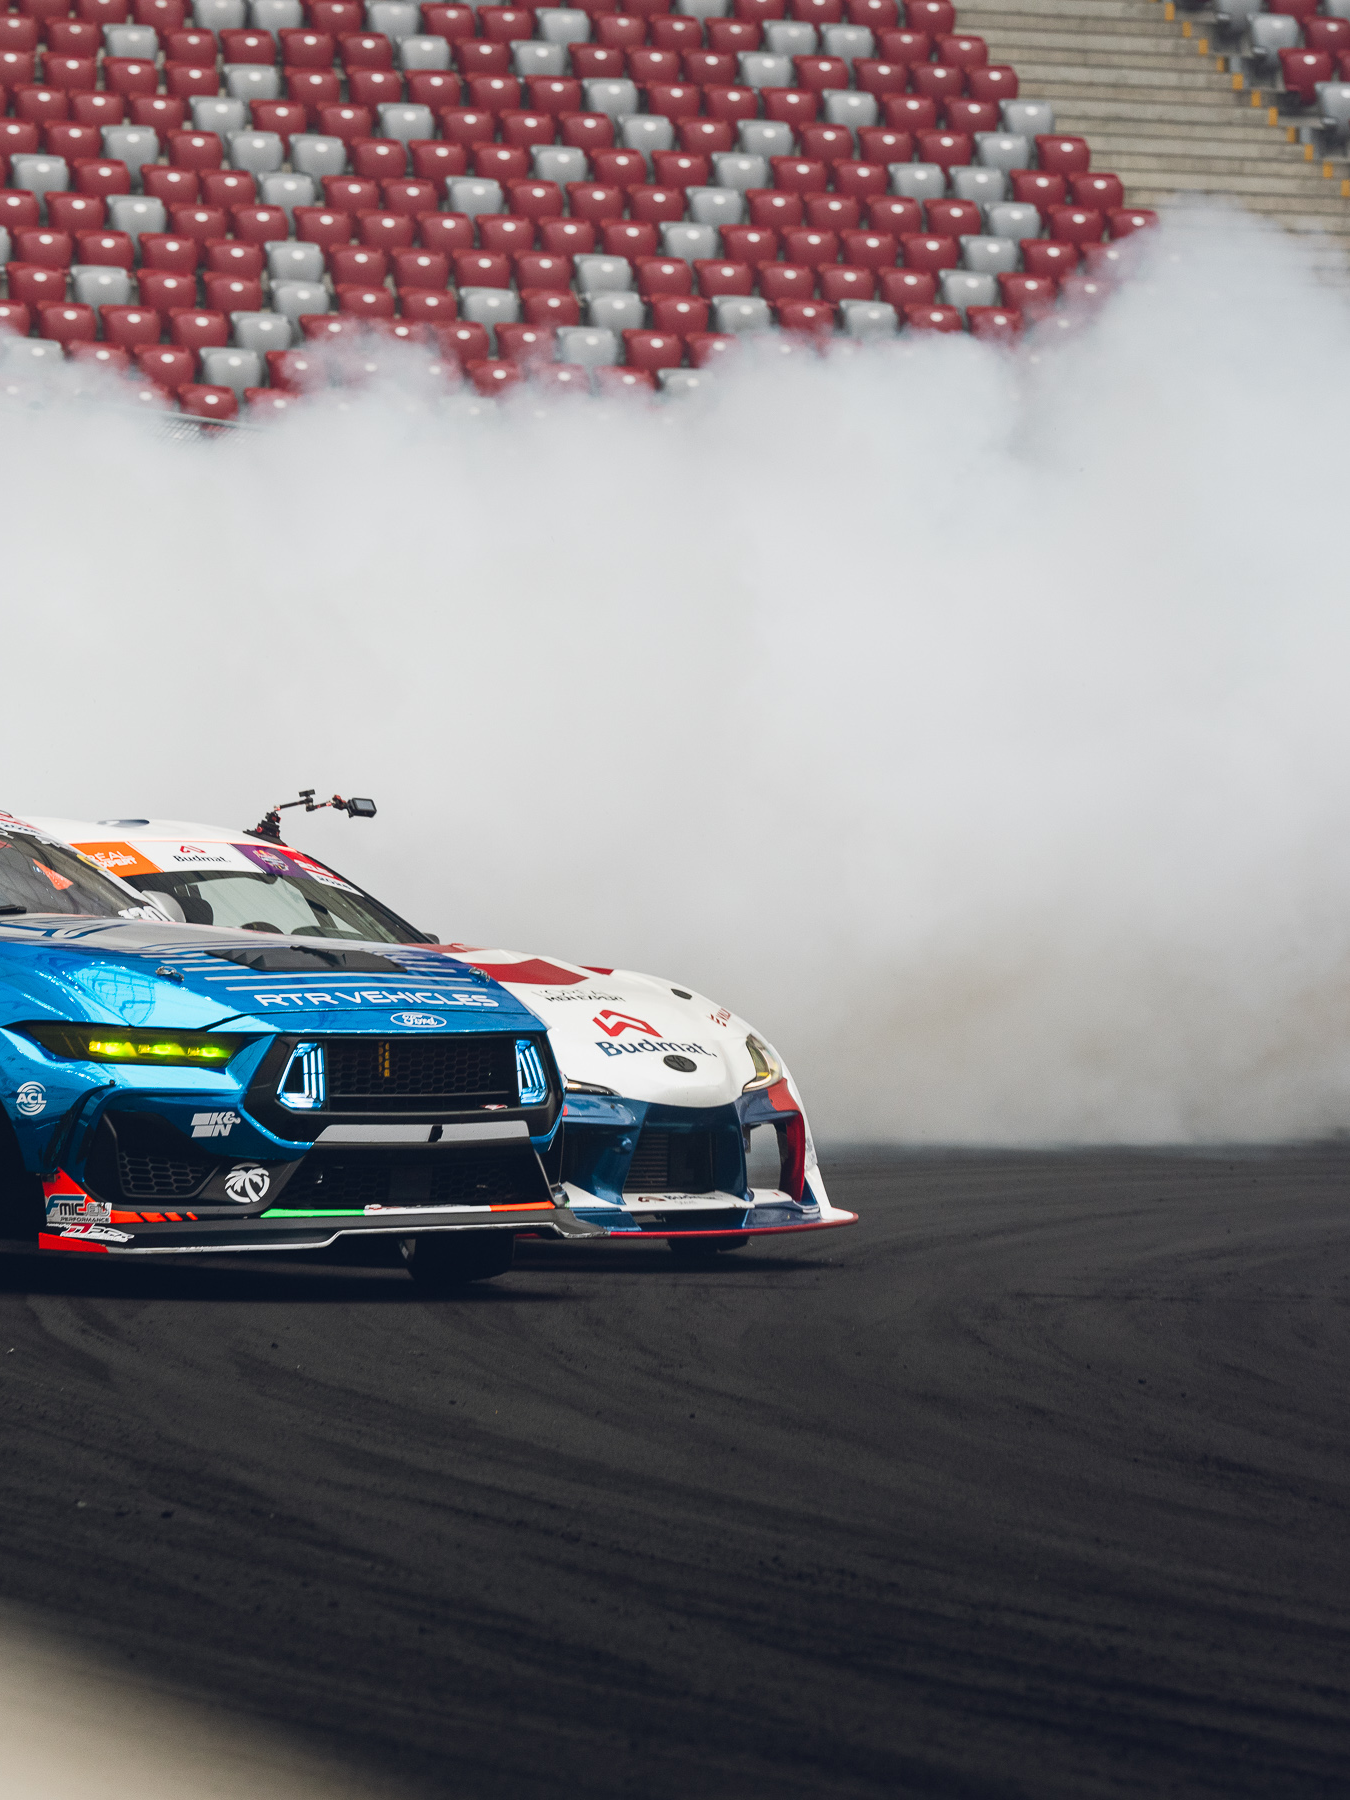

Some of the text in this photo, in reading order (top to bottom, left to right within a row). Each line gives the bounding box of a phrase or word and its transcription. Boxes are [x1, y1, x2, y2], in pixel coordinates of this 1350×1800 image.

[254, 990, 500, 1007] RTR VEHICLES
[398, 1013, 440, 1027] Ford
[16, 1092, 47, 1104] ACL
